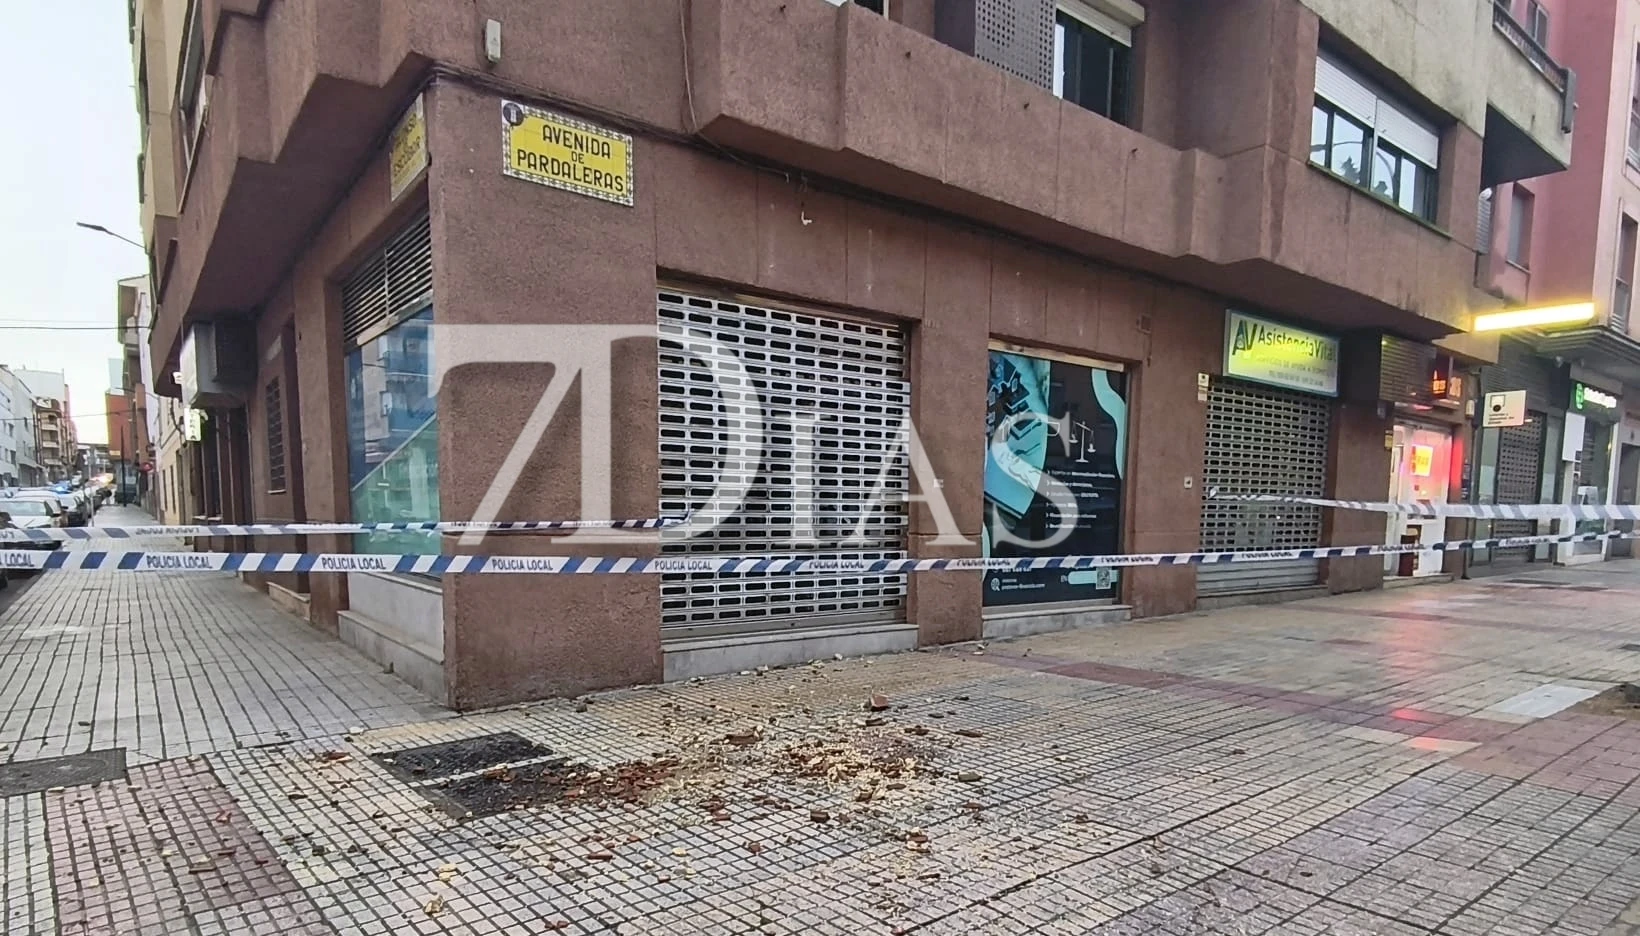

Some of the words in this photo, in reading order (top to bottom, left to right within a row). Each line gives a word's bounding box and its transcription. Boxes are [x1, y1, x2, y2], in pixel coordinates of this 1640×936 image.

[542, 124, 611, 159] AVENIDA
[571, 152, 585, 164] DE
[517, 149, 624, 192] PARDALERAS
[4, 553, 35, 568] LOCAL
[146, 554, 183, 569] POLICIA
[183, 555, 213, 569] LOCAL
[321, 557, 357, 570] POLICIA
[358, 558, 387, 570] LOCAL
[492, 558, 525, 571] POLICIA
[526, 559, 554, 571] LOCAL
[654, 560, 685, 571] POLICIA
[687, 560, 713, 571] LOCAL
